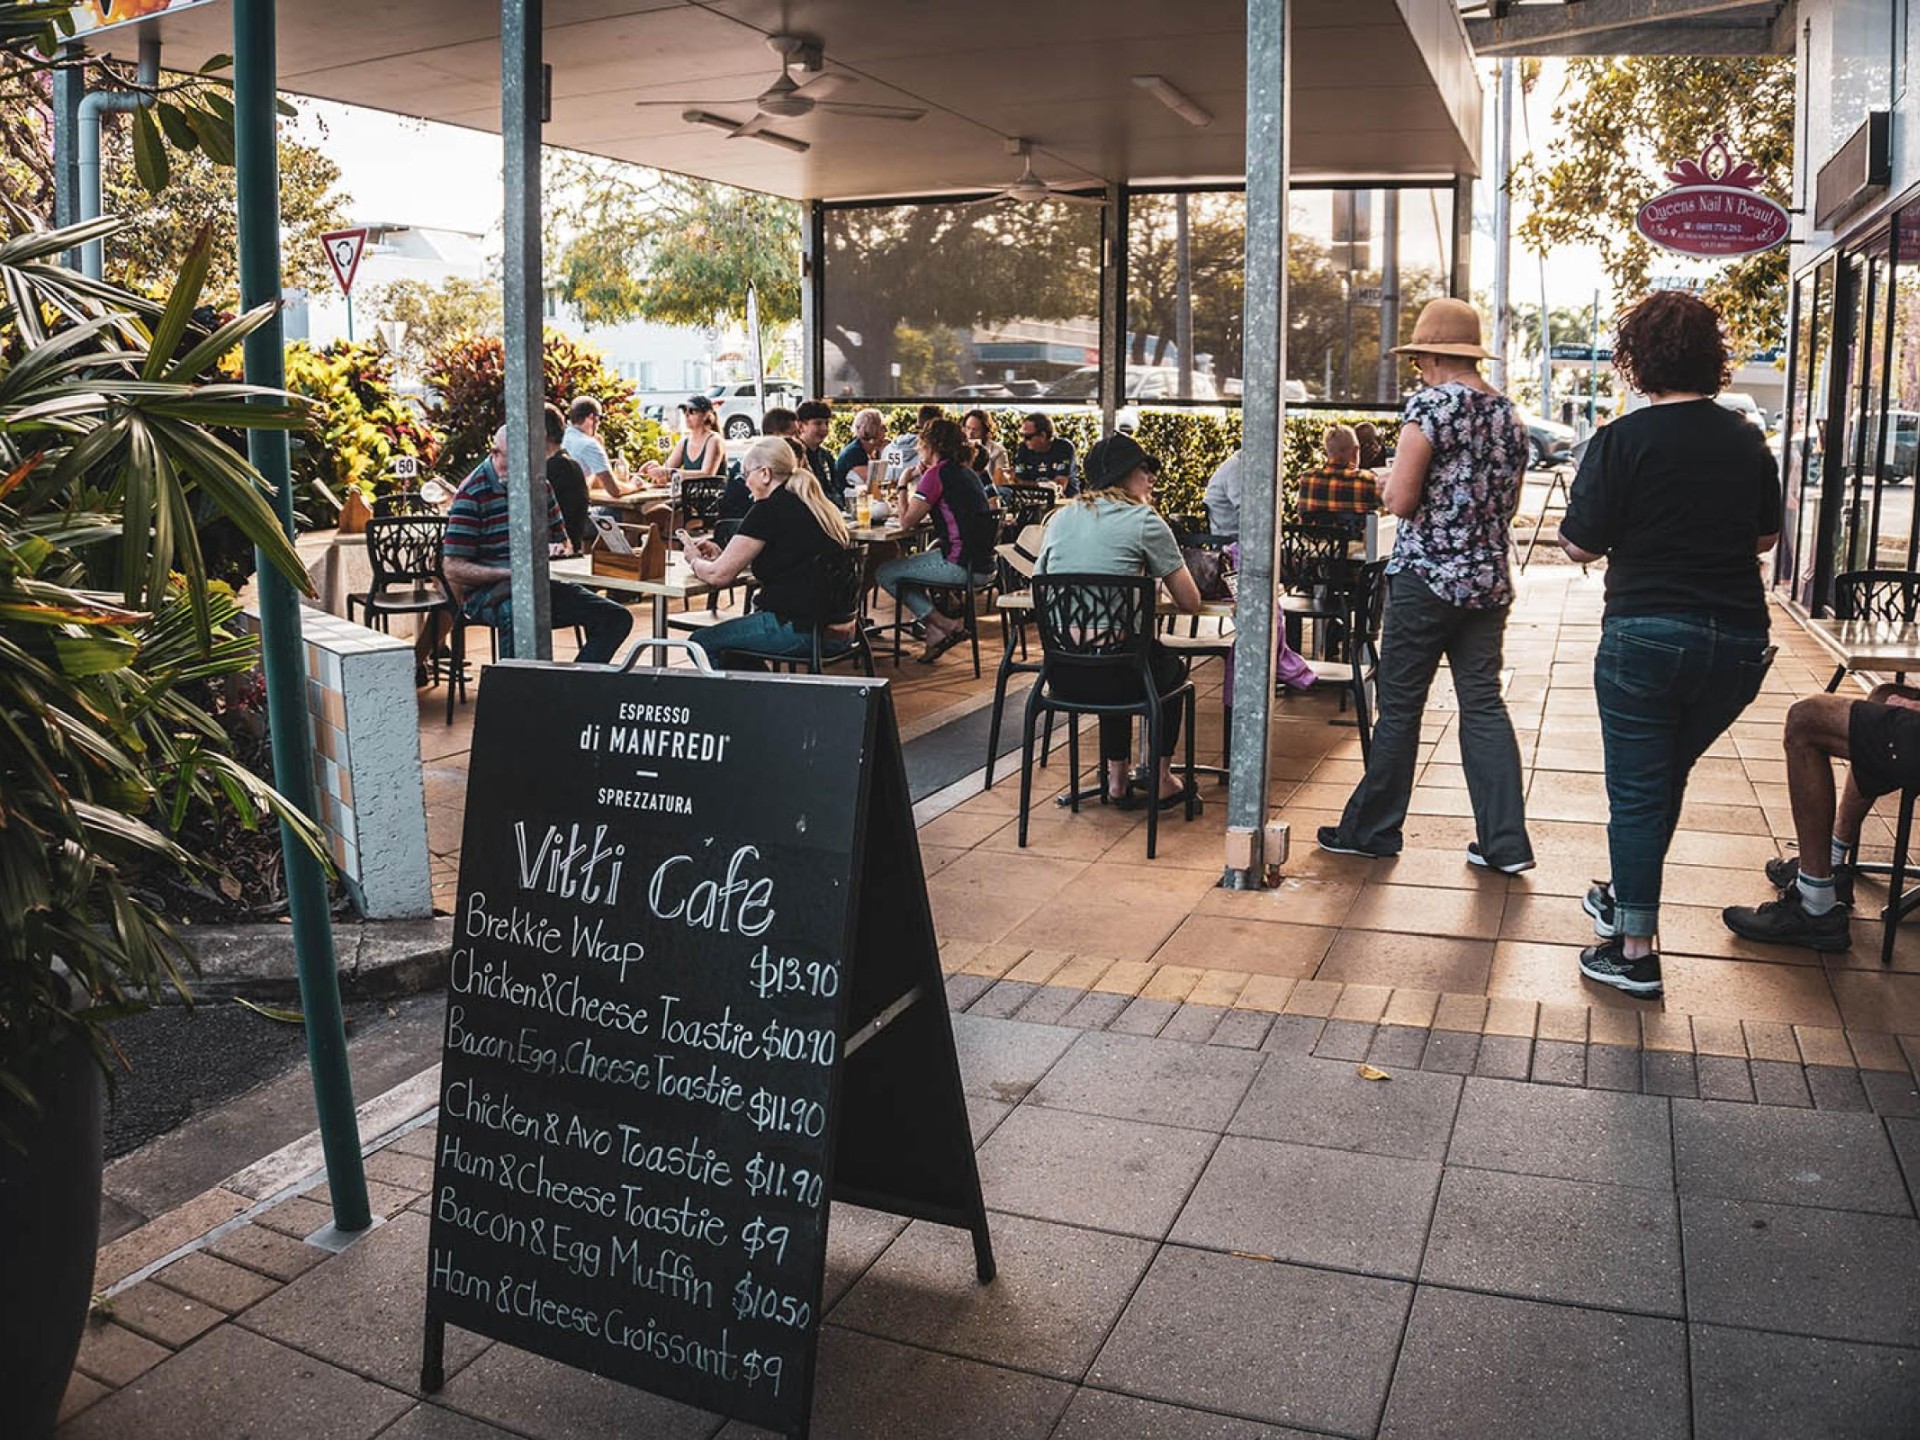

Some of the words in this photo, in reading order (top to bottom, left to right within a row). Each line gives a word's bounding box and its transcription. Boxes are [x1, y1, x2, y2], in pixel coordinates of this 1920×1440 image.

[1646, 199, 1695, 221] Queens
[1700, 194, 1721, 213] Nail
[1725, 196, 1733, 213] N
[1737, 198, 1781, 227] Beauty
[398, 459, 413, 473] 50
[888, 453, 900, 465] 55
[580, 724, 600, 750] di
[619, 702, 690, 724] ESPRESSO
[598, 787, 693, 815] SPREZZATURA
[514, 821, 625, 905] Vitti
[466, 892, 562, 953] Brekkie
[571, 915, 645, 983] Wrap
[750, 945, 838, 998] $13.90
[660, 995, 760, 1059] Toastie
[762, 1019, 836, 1066] $10.90
[654, 1054, 744, 1111] Toastie
[747, 1087, 825, 1137] $11.90
[566, 1115, 612, 1155] Avo
[617, 1123, 733, 1186] Toastie
[745, 1151, 823, 1208] $11.90
[620, 1184, 728, 1246] Toastie
[742, 1215, 789, 1265] $9
[610, 1235, 712, 1308] Muffin
[604, 1308, 738, 1381] Croissant
[743, 1349, 783, 1397] $9
